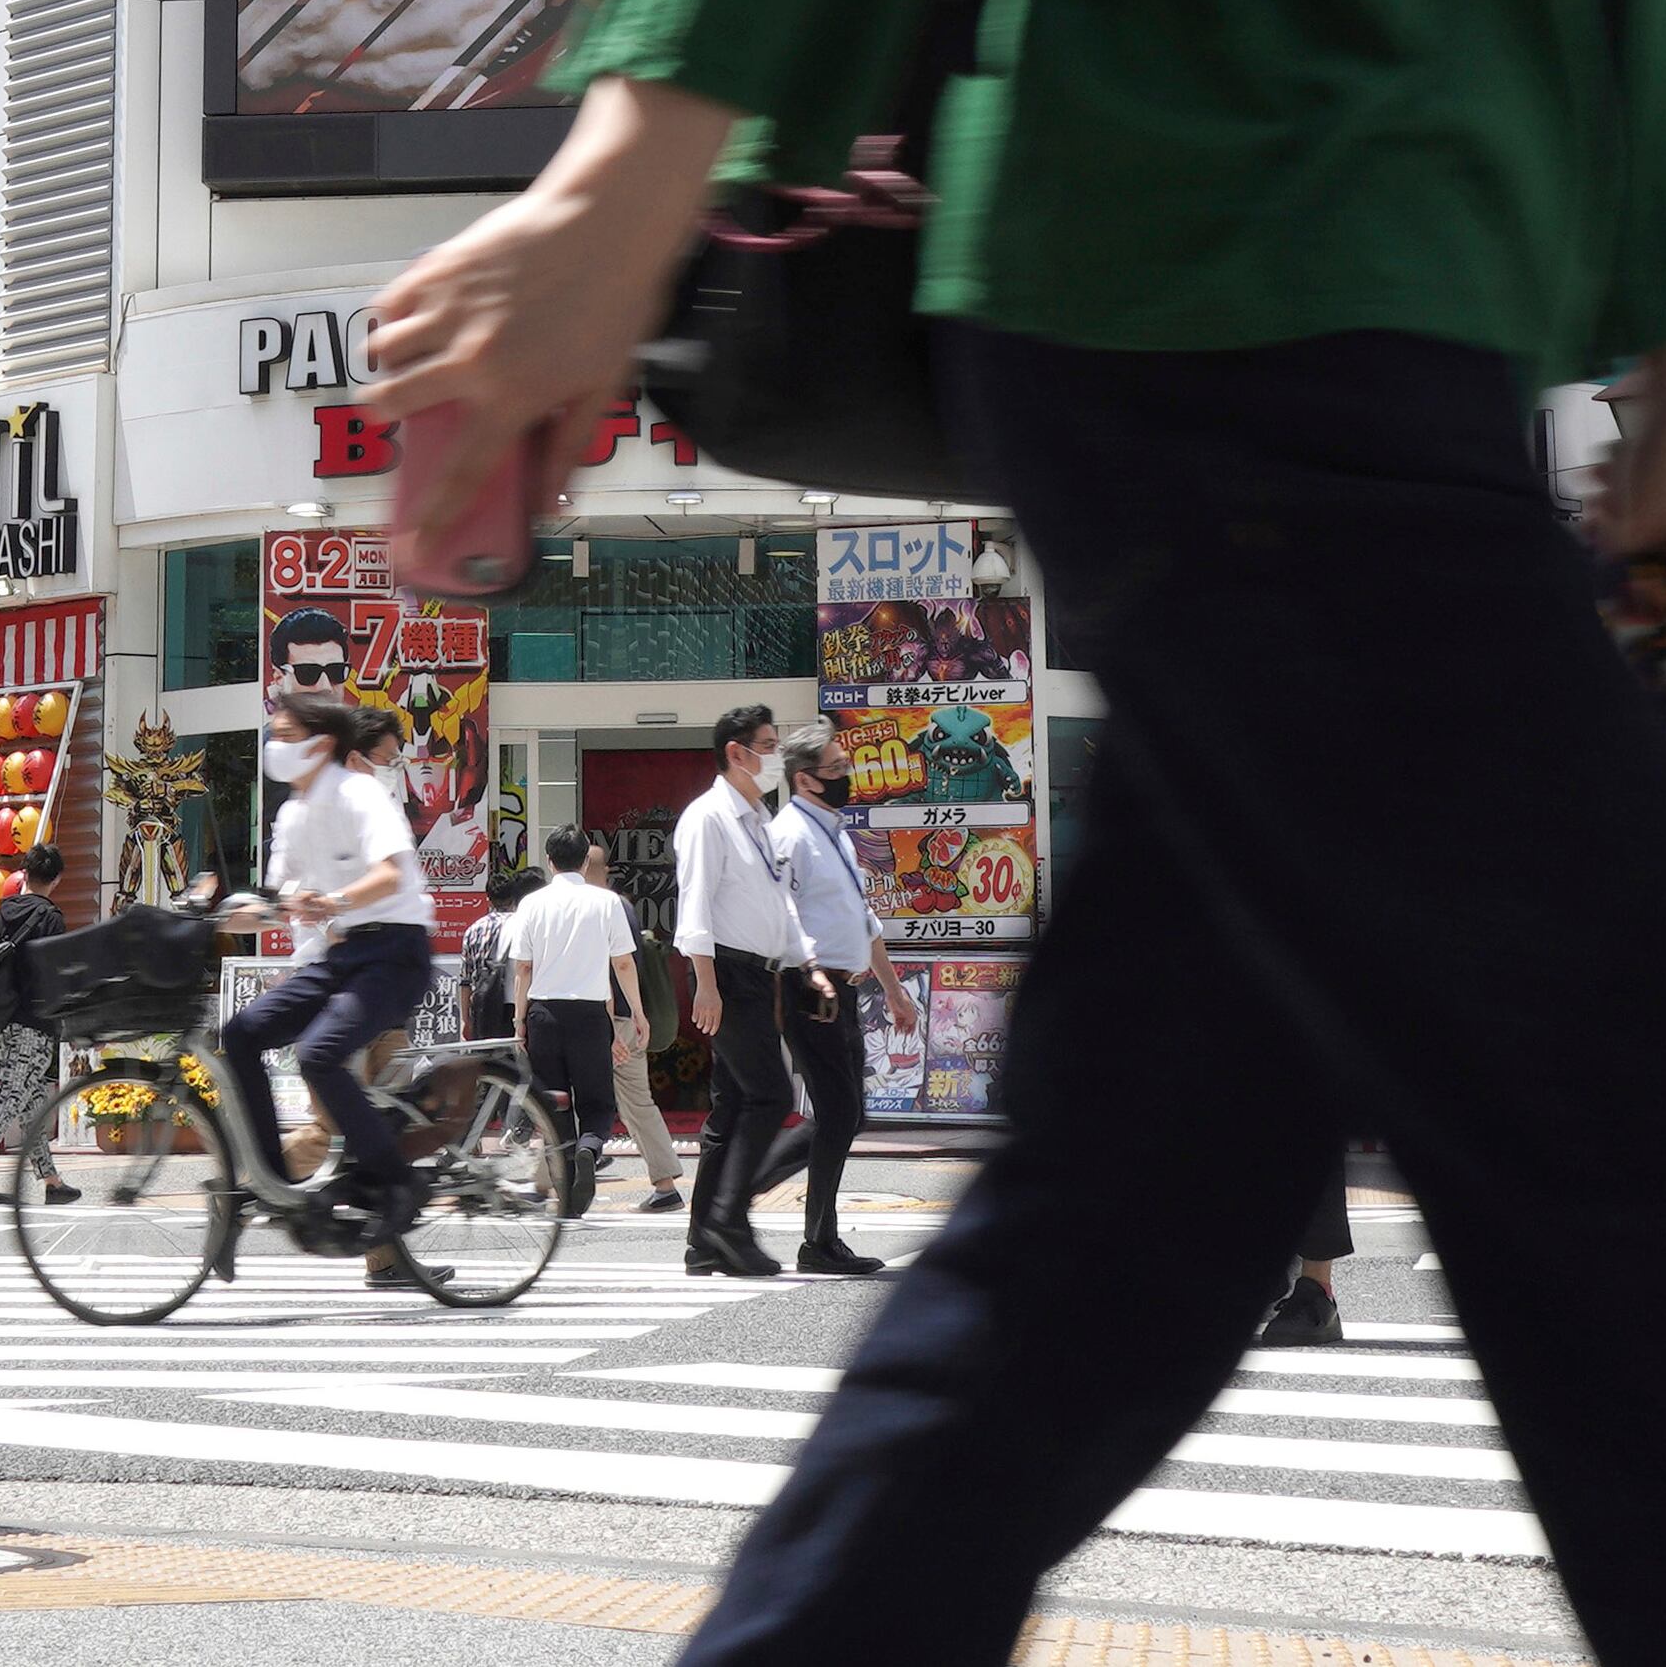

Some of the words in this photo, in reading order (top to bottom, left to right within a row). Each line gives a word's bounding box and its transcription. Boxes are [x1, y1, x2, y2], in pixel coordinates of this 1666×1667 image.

[358, 548, 388, 566] MON
[827, 524, 965, 575] スロット
[269, 536, 351, 590] 8.2
[827, 575, 963, 601] 最新機種設置中
[824, 690, 864, 704] スロット
[885, 685, 1006, 706] 鉄拳4デビルver
[922, 807, 967, 826] ガメラ
[940, 964, 979, 987] 8.2
